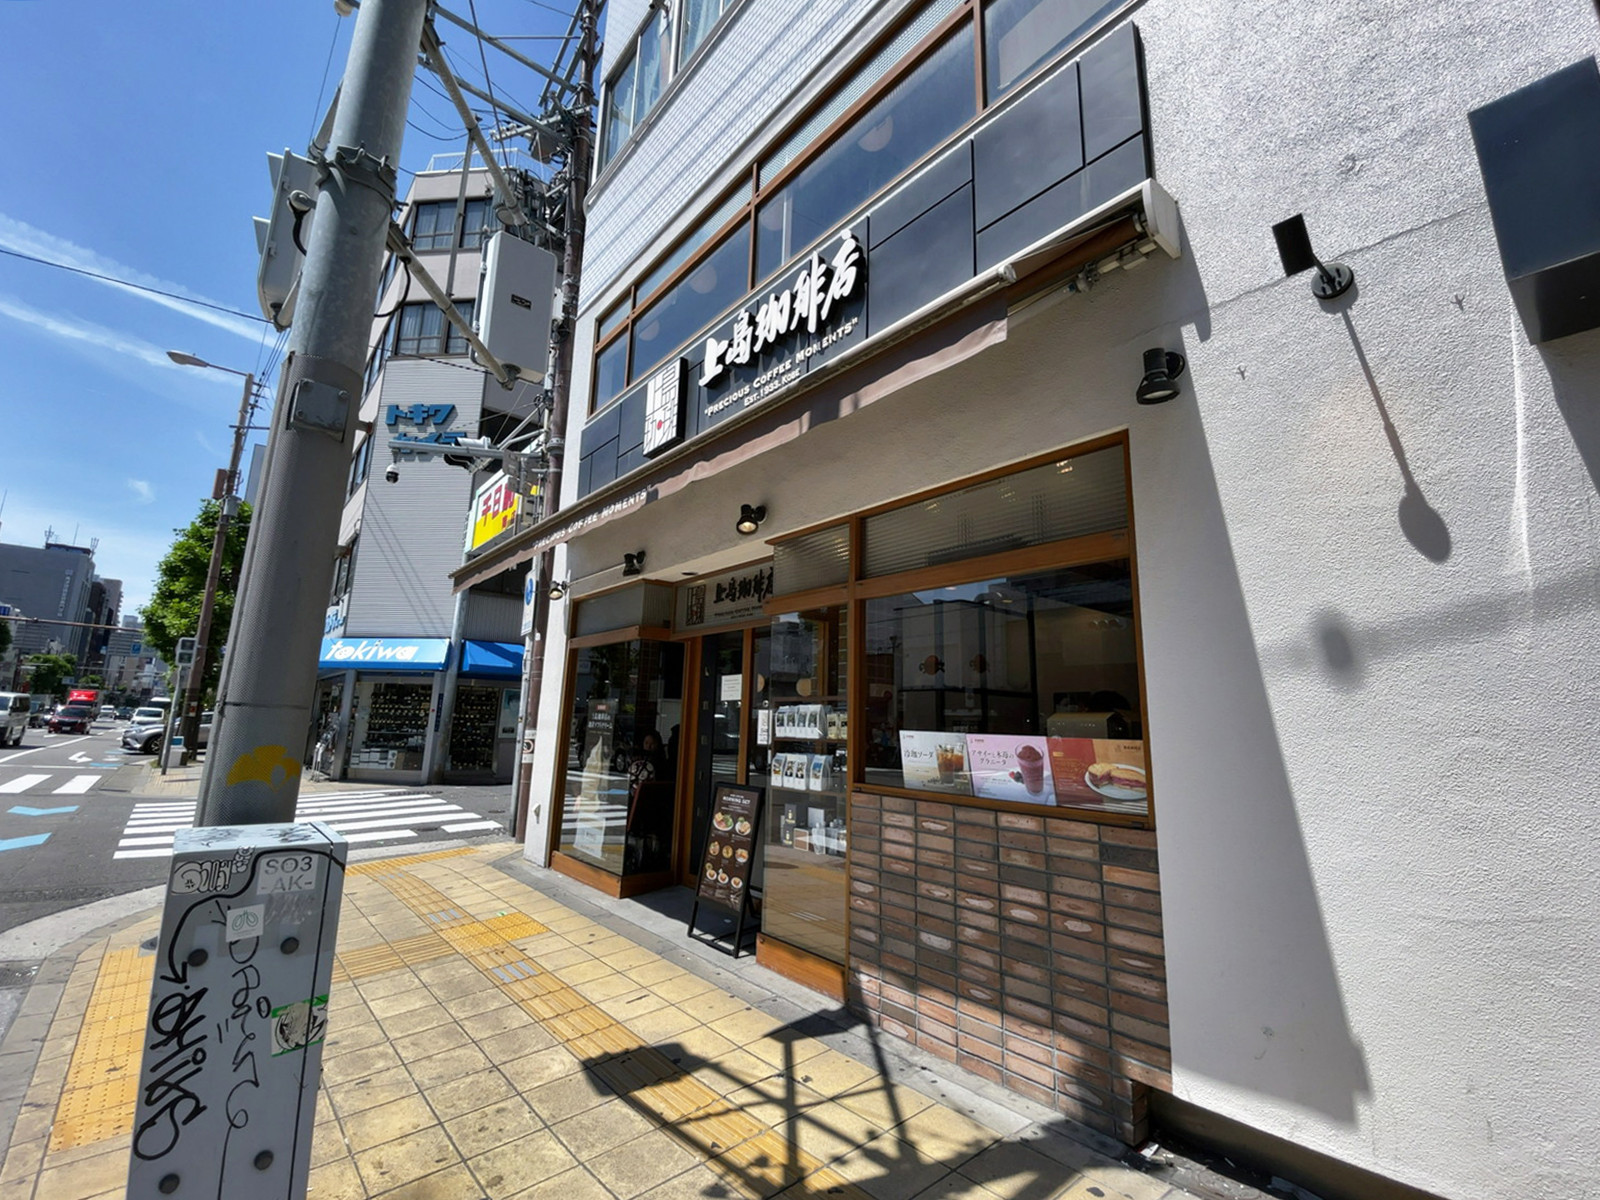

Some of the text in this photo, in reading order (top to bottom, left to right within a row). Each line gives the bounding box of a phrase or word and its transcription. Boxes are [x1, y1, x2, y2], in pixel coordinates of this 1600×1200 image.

[753, 362, 791, 388] COFFEE
[385, 404, 456, 426] トキワ
[325, 640, 420, 660] tokiwa
